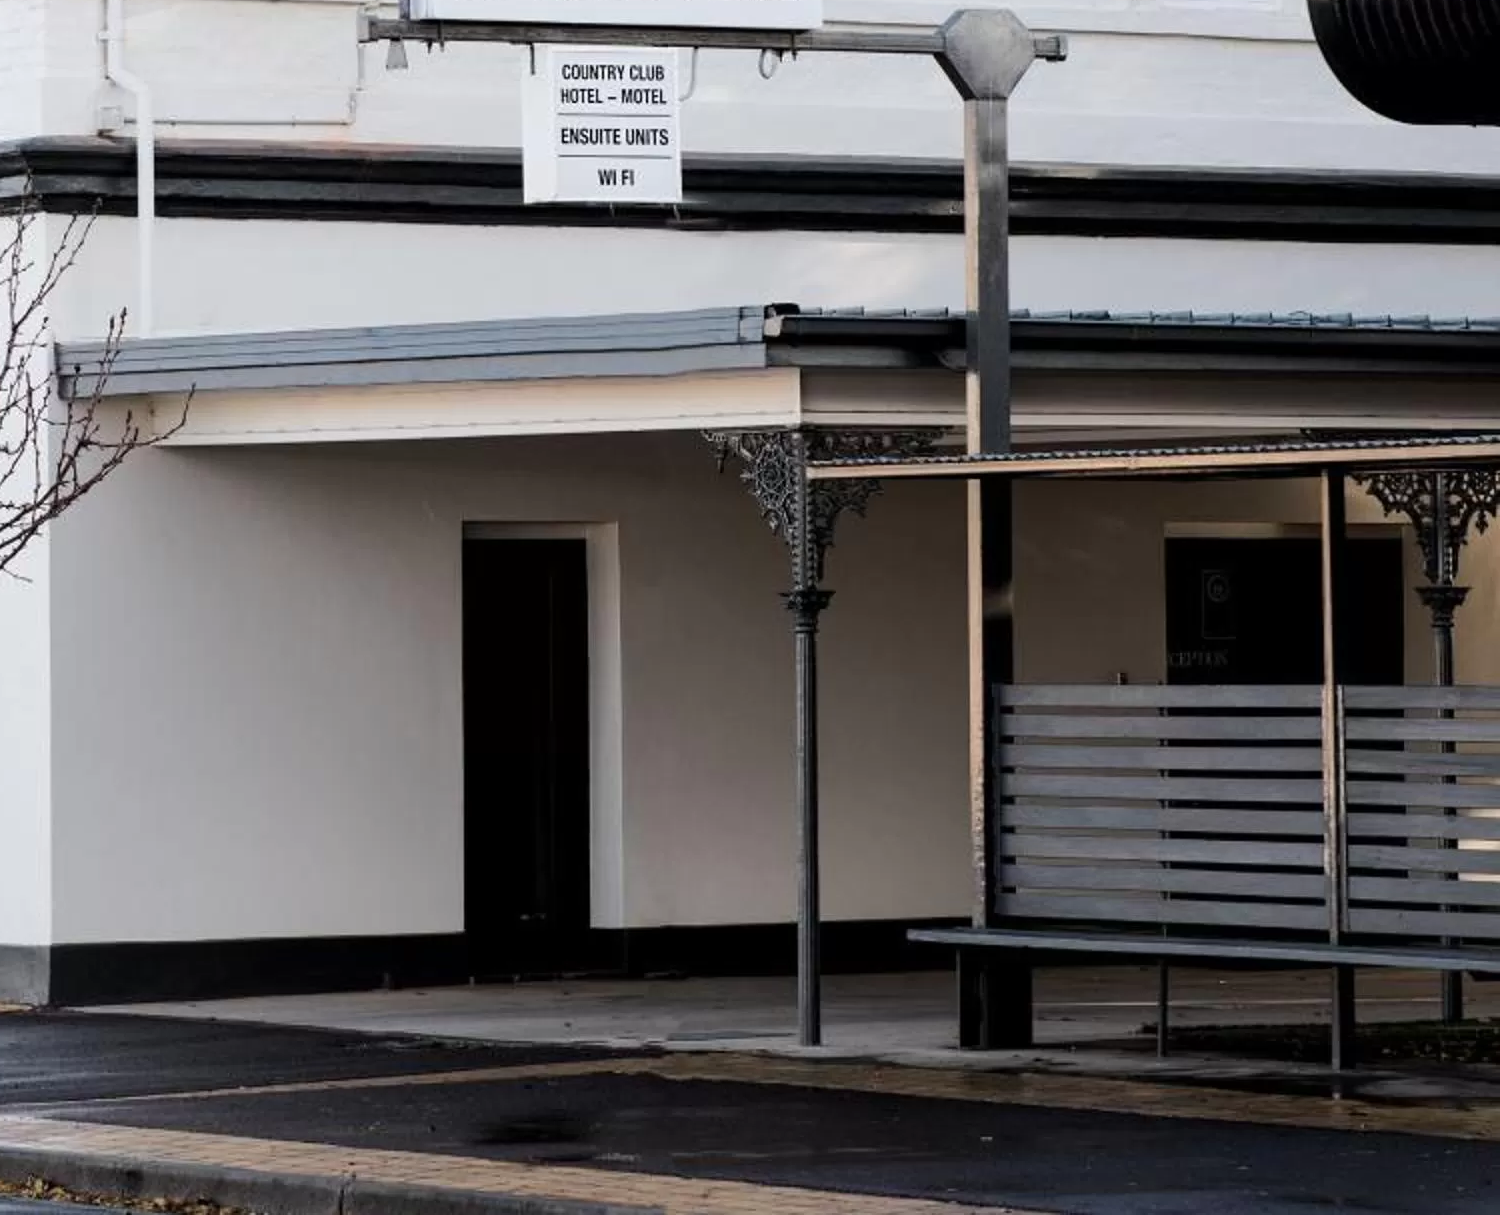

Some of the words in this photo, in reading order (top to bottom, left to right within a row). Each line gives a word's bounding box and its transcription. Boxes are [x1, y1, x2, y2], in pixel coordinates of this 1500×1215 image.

[561, 64, 625, 81] COUNTRY
[629, 64, 665, 82] CLUB
[560, 88, 603, 104] HOTEL
[620, 88, 668, 105] MOTEL
[560, 128, 621, 146] ENSUITE
[624, 128, 670, 147] UNITS
[597, 169, 618, 186] WI
[620, 169, 636, 187] FI
